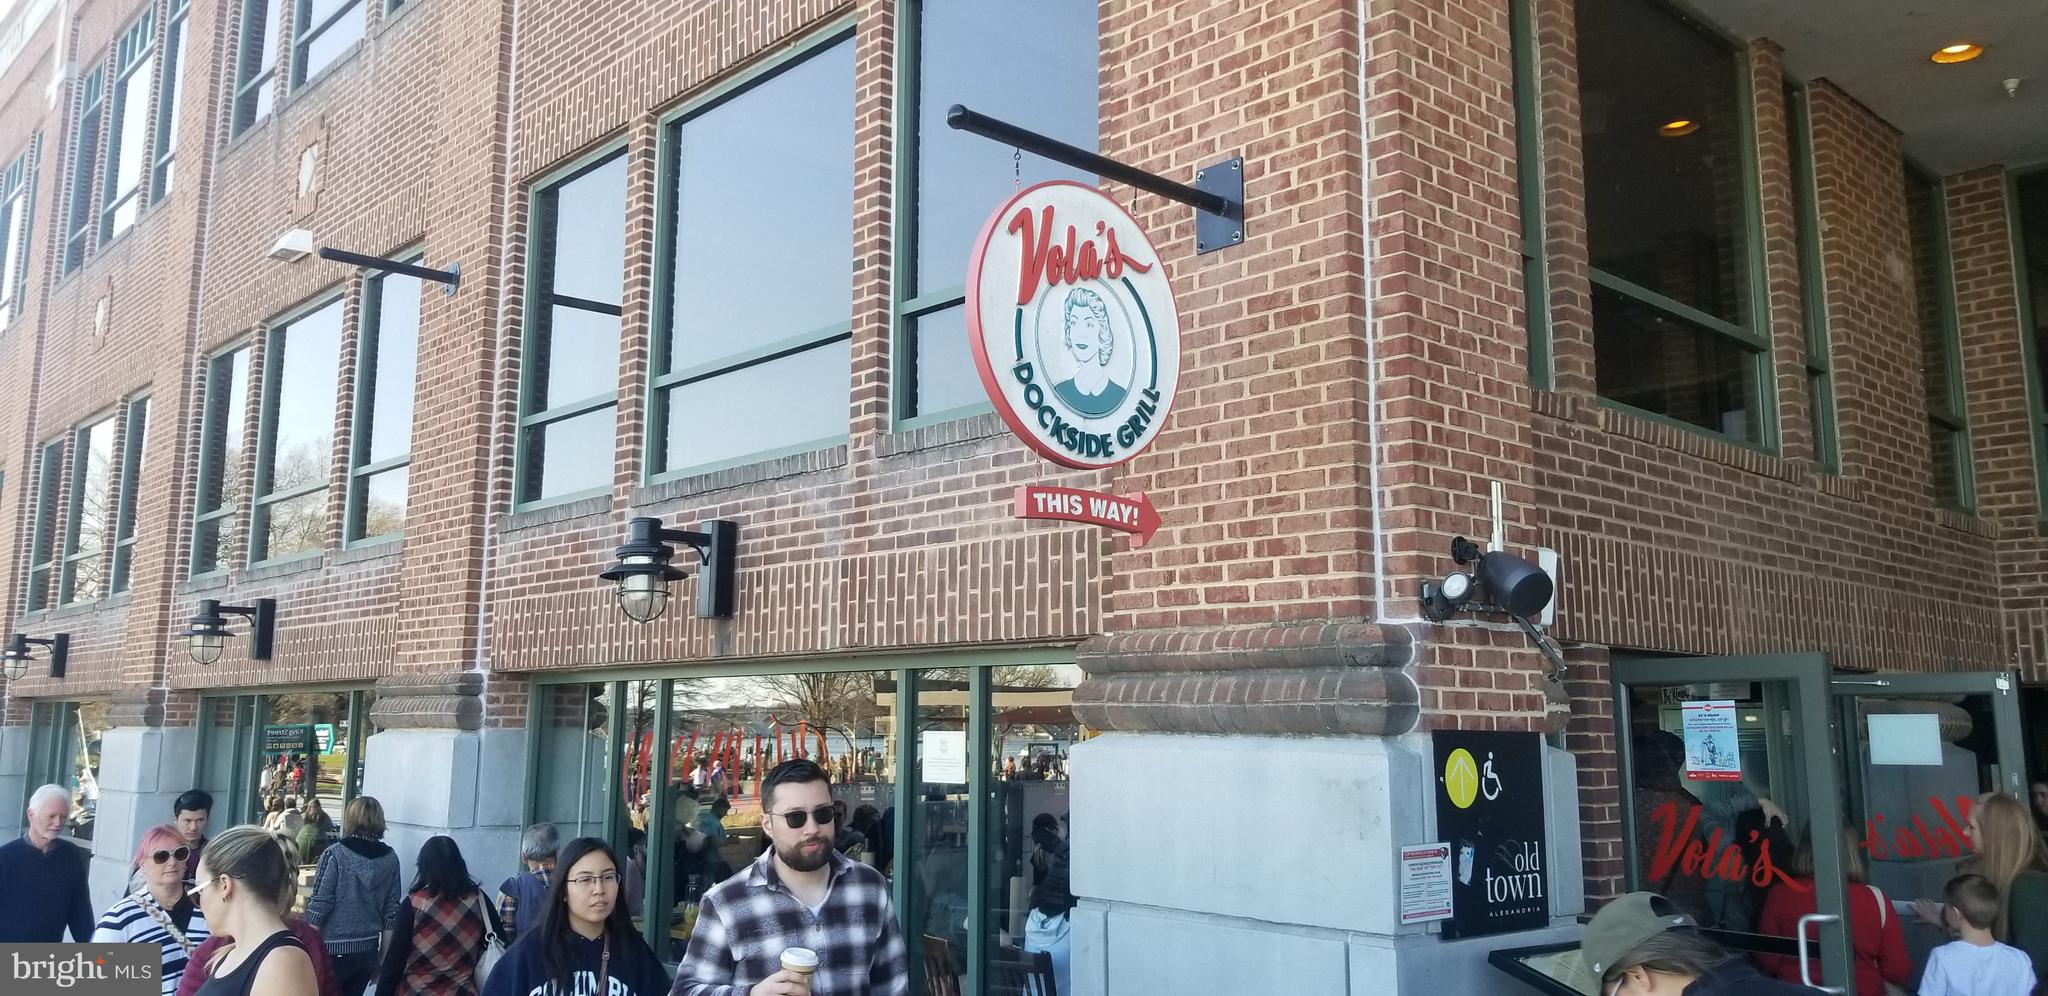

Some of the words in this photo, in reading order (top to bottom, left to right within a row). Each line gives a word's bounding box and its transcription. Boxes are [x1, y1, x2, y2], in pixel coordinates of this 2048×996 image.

[1008, 205, 1153, 305] Vola's
[1012, 361, 1114, 458] DOCKSIDE
[1116, 387, 1161, 449] GRILL
[1033, 492, 1083, 515] THIS
[1089, 497, 1139, 526] WAY!
[1514, 841, 1540, 872] old
[1647, 800, 1811, 892] Vola's
[1485, 867, 1543, 903] town
[1489, 906, 1541, 918] ALEXANDRIA
